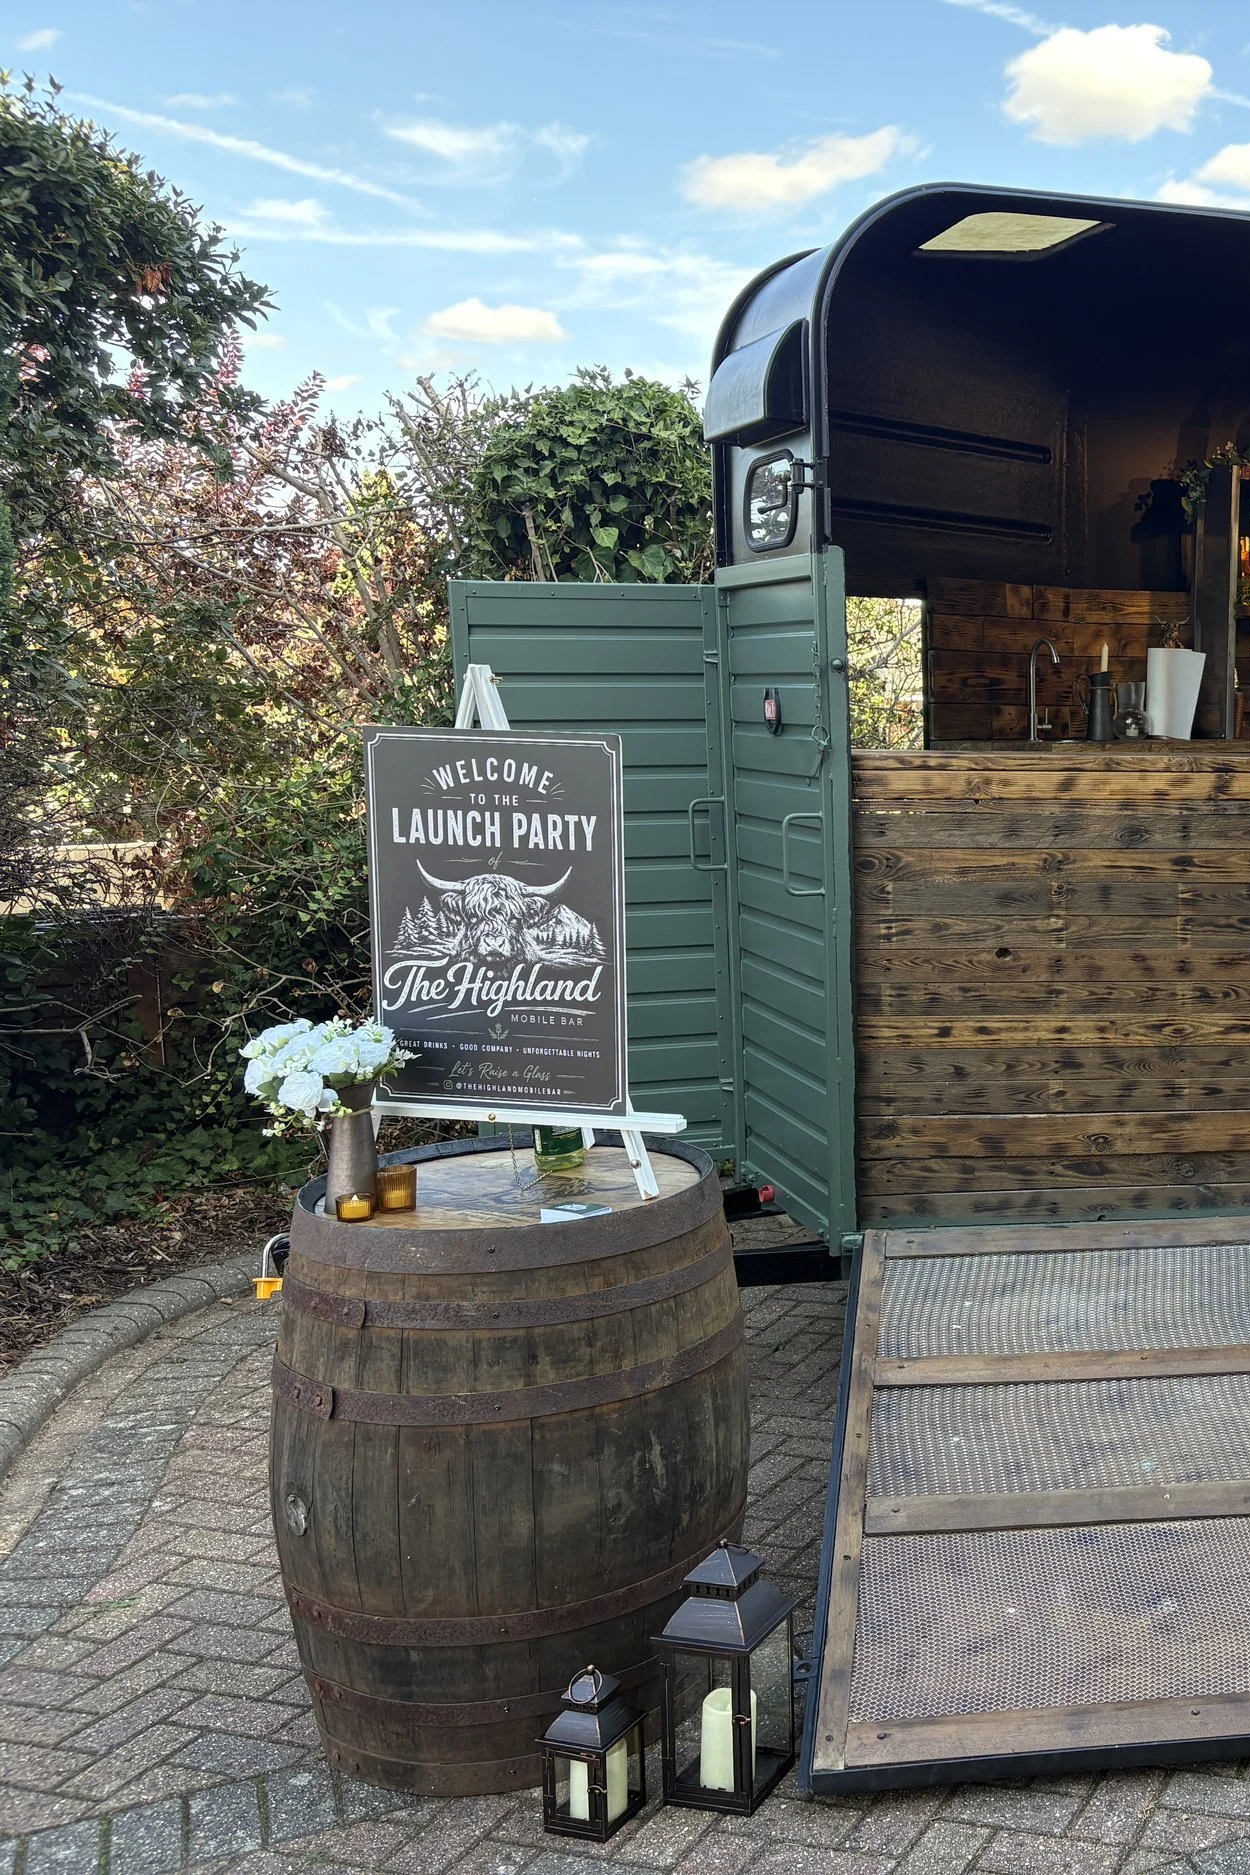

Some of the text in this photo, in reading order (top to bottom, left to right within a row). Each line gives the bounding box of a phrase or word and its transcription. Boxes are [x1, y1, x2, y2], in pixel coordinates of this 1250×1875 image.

[432, 757, 554, 795] WELCOME
[470, 793, 519, 806] TO THE
[392, 807, 597, 851] LAUNCH PARTY
[488, 851, 503, 870] of
[382, 956, 604, 1018] The Highland
[511, 1014, 583, 1027] MOBILE BAR
[400, 1040, 601, 1059] GREAT DRINKS GOOD COMPANY UNFORGETTABLE NIGHTS
[448, 1060, 551, 1082] Let's Raise a Glass
[456, 1082, 561, 1096] @THEHIGHLANDMOBILEBAR
